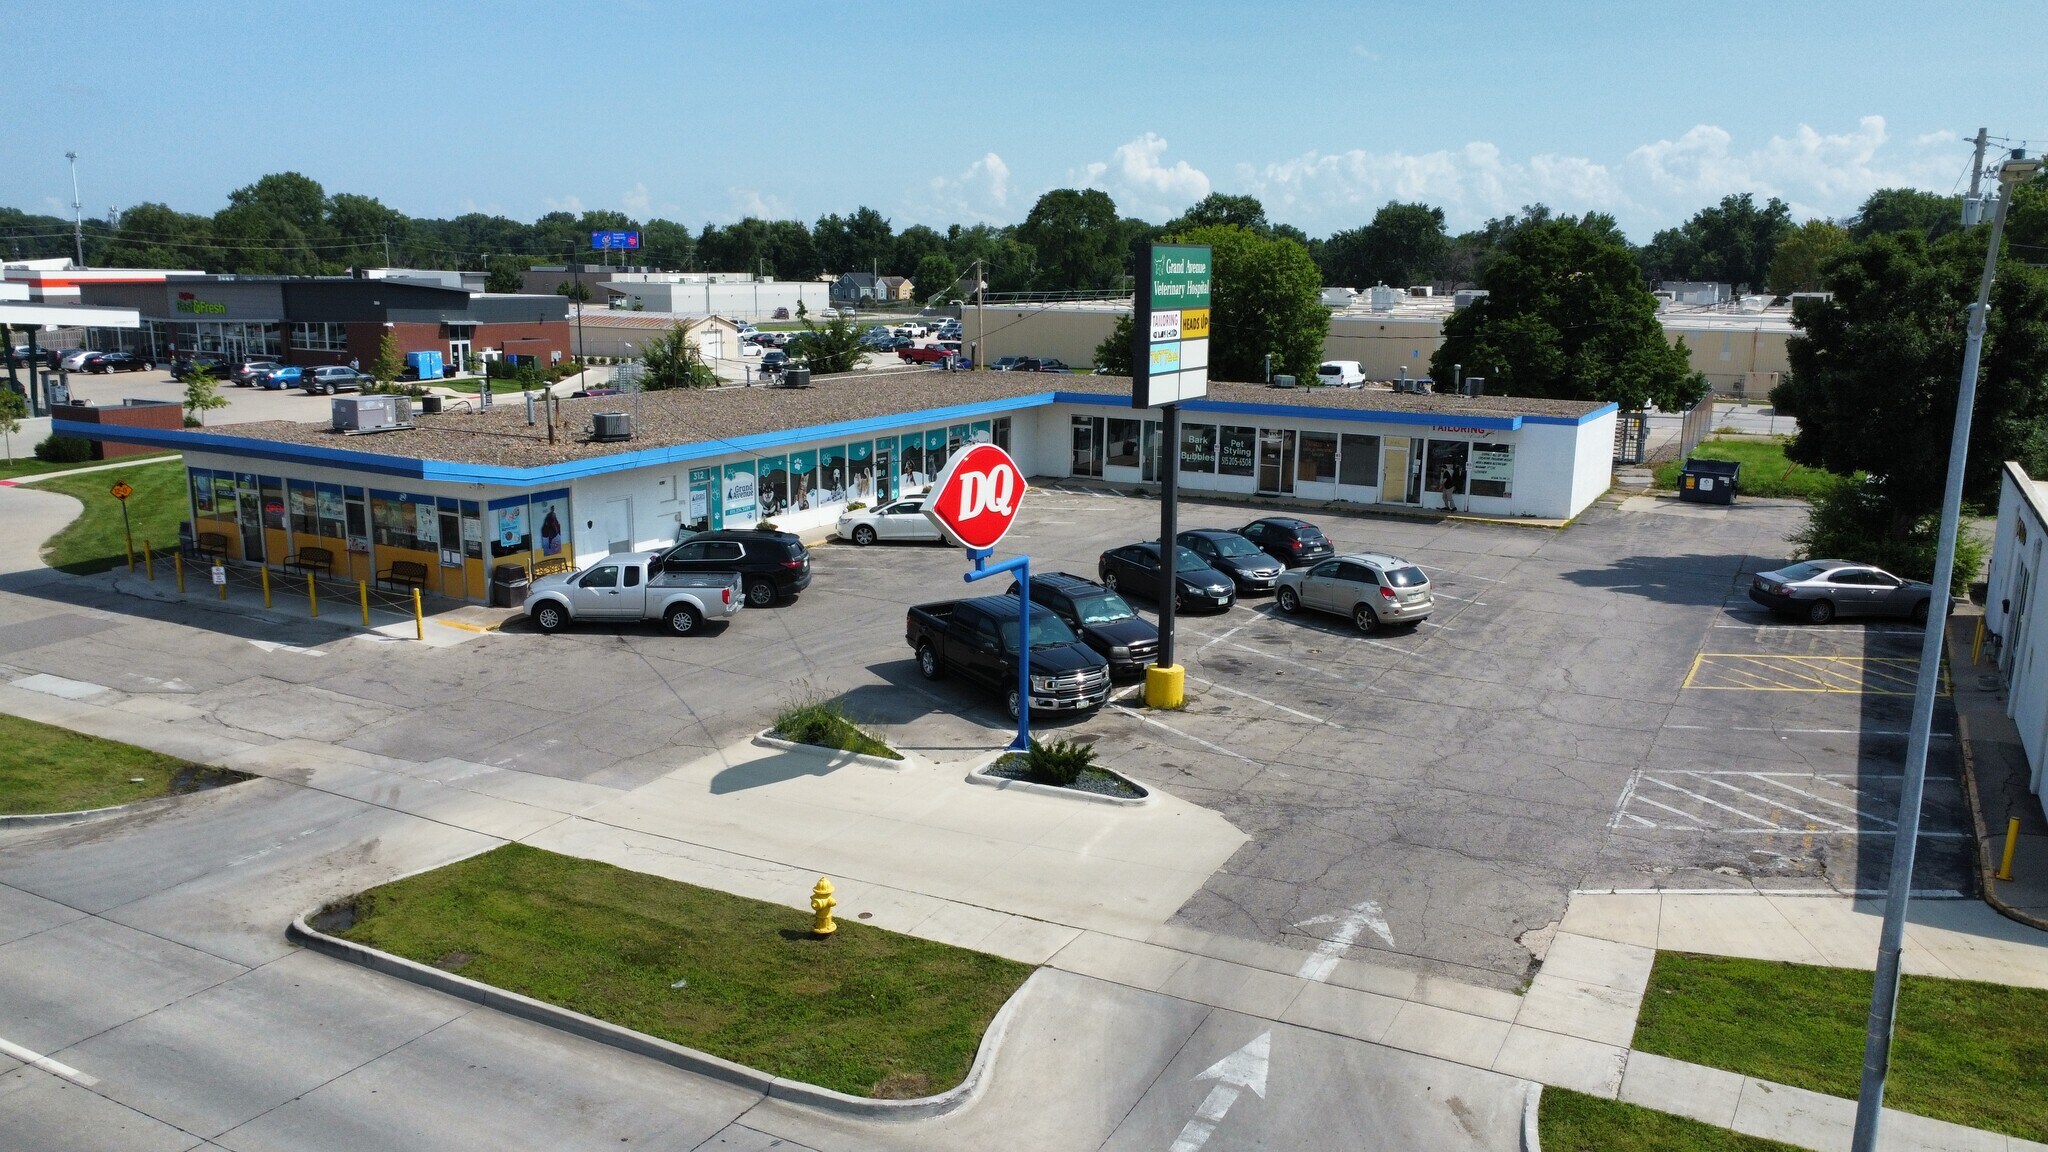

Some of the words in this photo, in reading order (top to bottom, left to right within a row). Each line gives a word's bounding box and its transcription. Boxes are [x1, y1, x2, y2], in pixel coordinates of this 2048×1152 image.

[1166, 258, 1184, 274] Grand
[1186, 259, 1206, 274] Avenue
[1154, 280, 1185, 298] Veterinary
[1187, 280, 1210, 298] Hospital
[1153, 314, 1178, 327] TAILORING
[1182, 317, 1200, 331] HEADS
[1200, 313, 1209, 330] UP
[1188, 435, 1208, 445] Bark
[1230, 439, 1245, 448] Pet
[1195, 444, 1202, 452] N
[1223, 446, 1252, 458] Styling
[1181, 451, 1215, 462] Bubbles
[693, 470, 704, 481] 312
[734, 482, 754, 494] Grand
[958, 463, 1014, 521] DQ
[732, 489, 754, 500] Avenue
